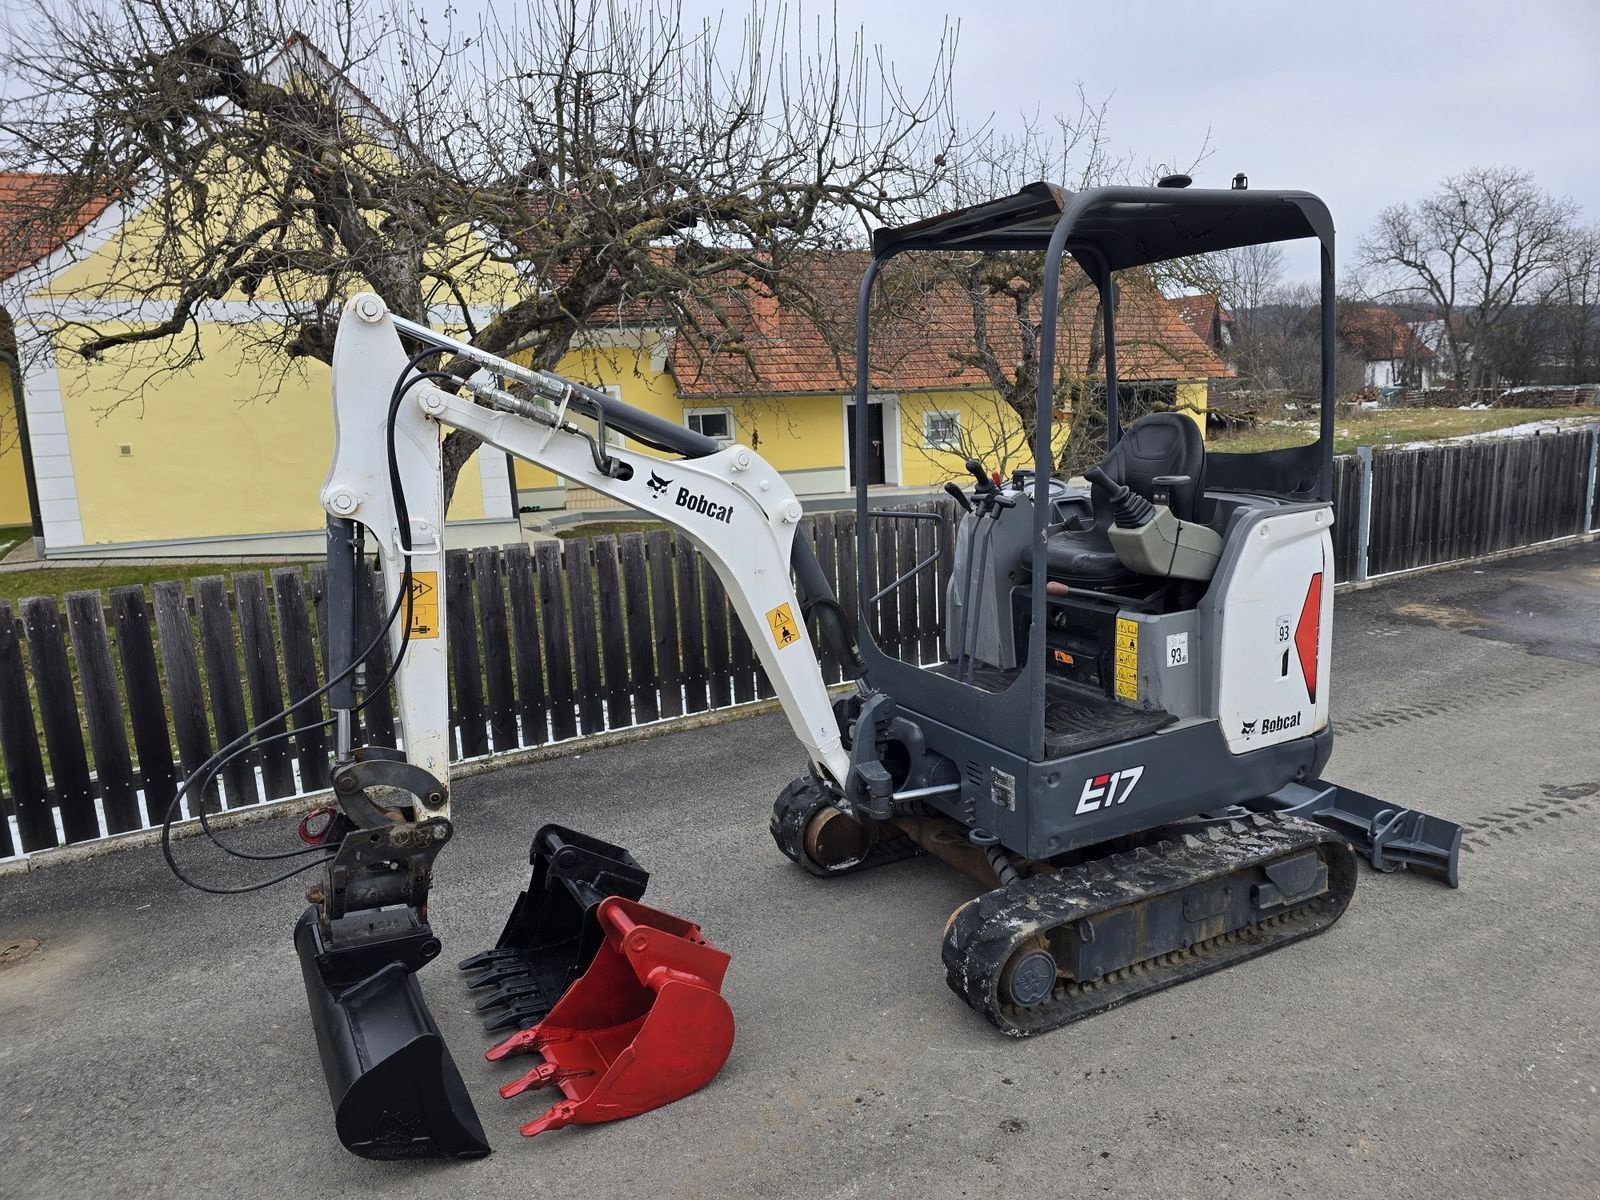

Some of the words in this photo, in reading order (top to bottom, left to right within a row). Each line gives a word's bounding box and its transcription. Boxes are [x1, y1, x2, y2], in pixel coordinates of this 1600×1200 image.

[675, 486, 734, 524] Bobcat
[1279, 625, 1290, 642] 93
[1171, 647, 1182, 664] 93
[1261, 710, 1302, 735] Bobcat
[1073, 765, 1145, 816] E17
